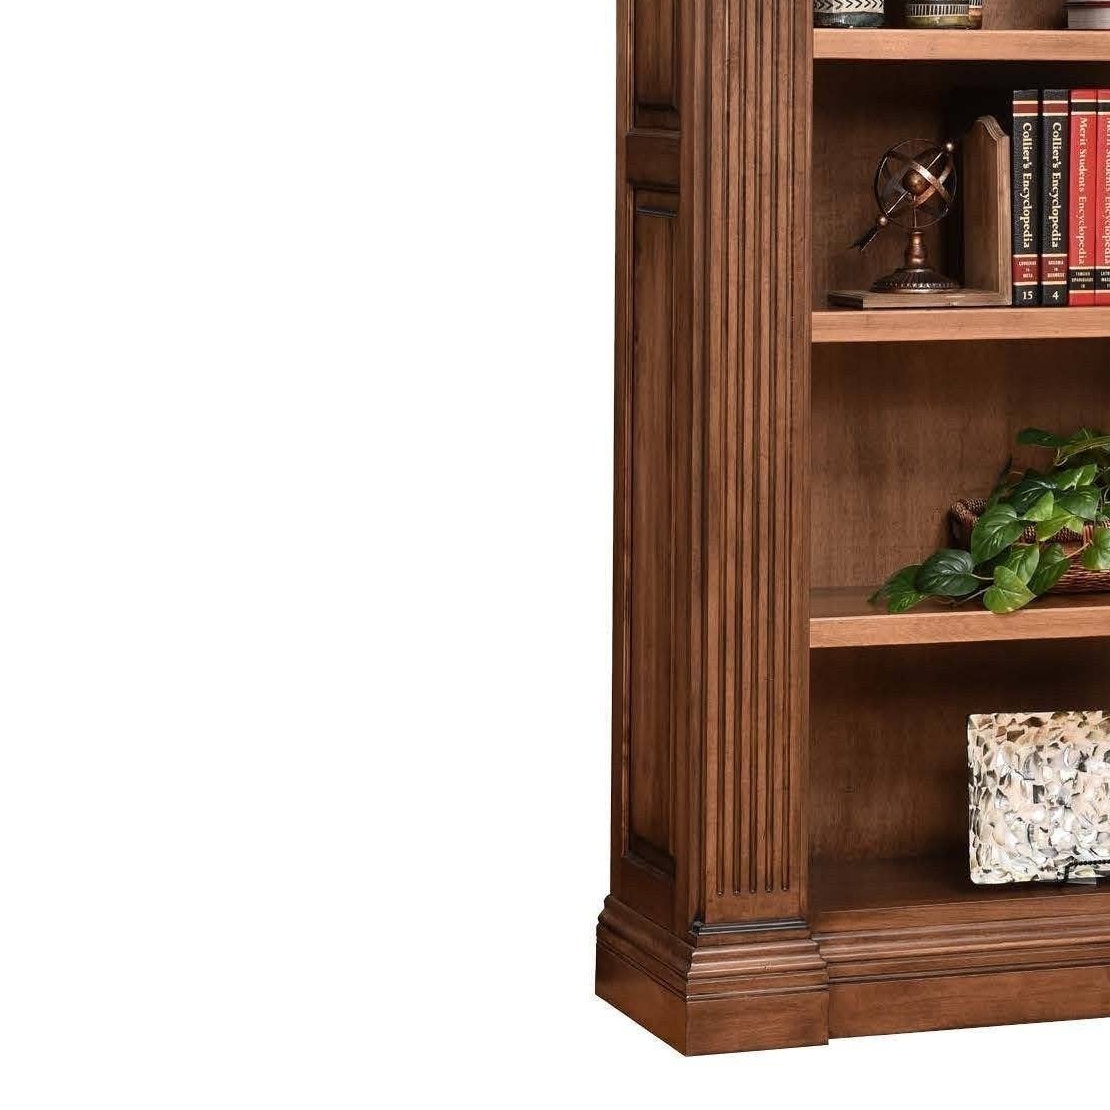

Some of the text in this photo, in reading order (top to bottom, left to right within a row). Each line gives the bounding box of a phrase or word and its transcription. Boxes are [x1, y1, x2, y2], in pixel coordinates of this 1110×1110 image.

[1021, 122, 1033, 169] Collier's
[1052, 122, 1062, 169] Collier's
[1079, 117, 1088, 149] Merit
[1078, 150, 1088, 194] Students
[1019, 171, 1033, 249] Encyclopedia
[1048, 171, 1062, 249] Encyclopedia
[1075, 195, 1087, 266] Encyclopedia
[1022, 291, 1033, 300] 15
[1052, 290, 1059, 300] 4
